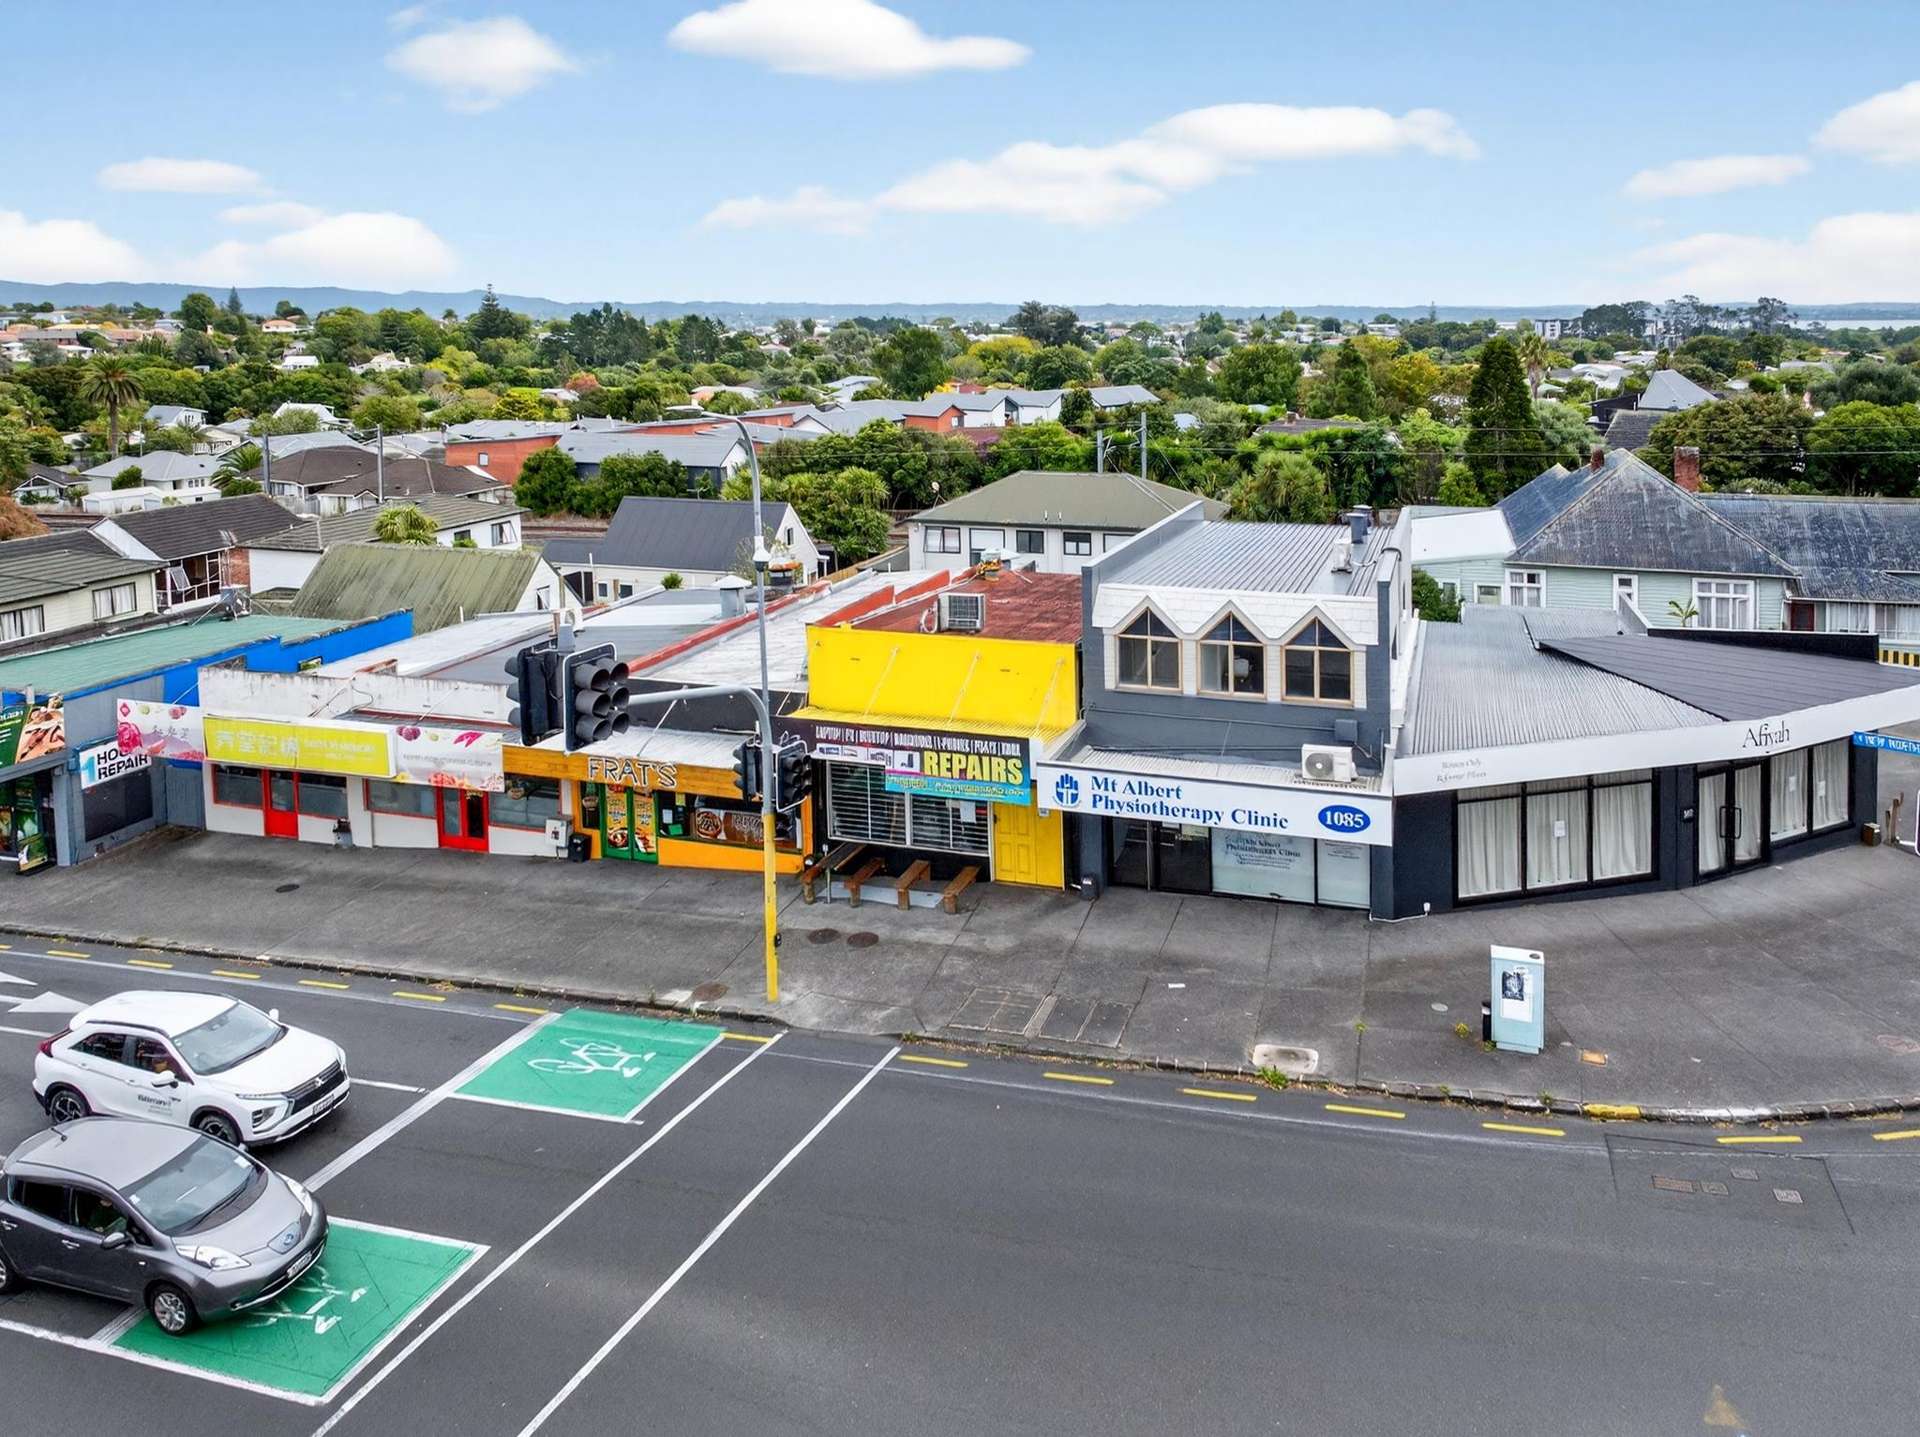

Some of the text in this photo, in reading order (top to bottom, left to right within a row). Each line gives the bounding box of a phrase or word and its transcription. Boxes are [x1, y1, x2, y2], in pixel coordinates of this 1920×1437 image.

[1742, 720, 1790, 747] Afiyah
[98, 754, 148, 779] REPAIR
[588, 757, 677, 788] FRAT'S
[923, 750, 1024, 785] REPAIRS
[1090, 776, 1182, 800] Mt Albert
[1091, 794, 1289, 829] Physiotherapy Clinic
[1325, 811, 1364, 828] 1085
